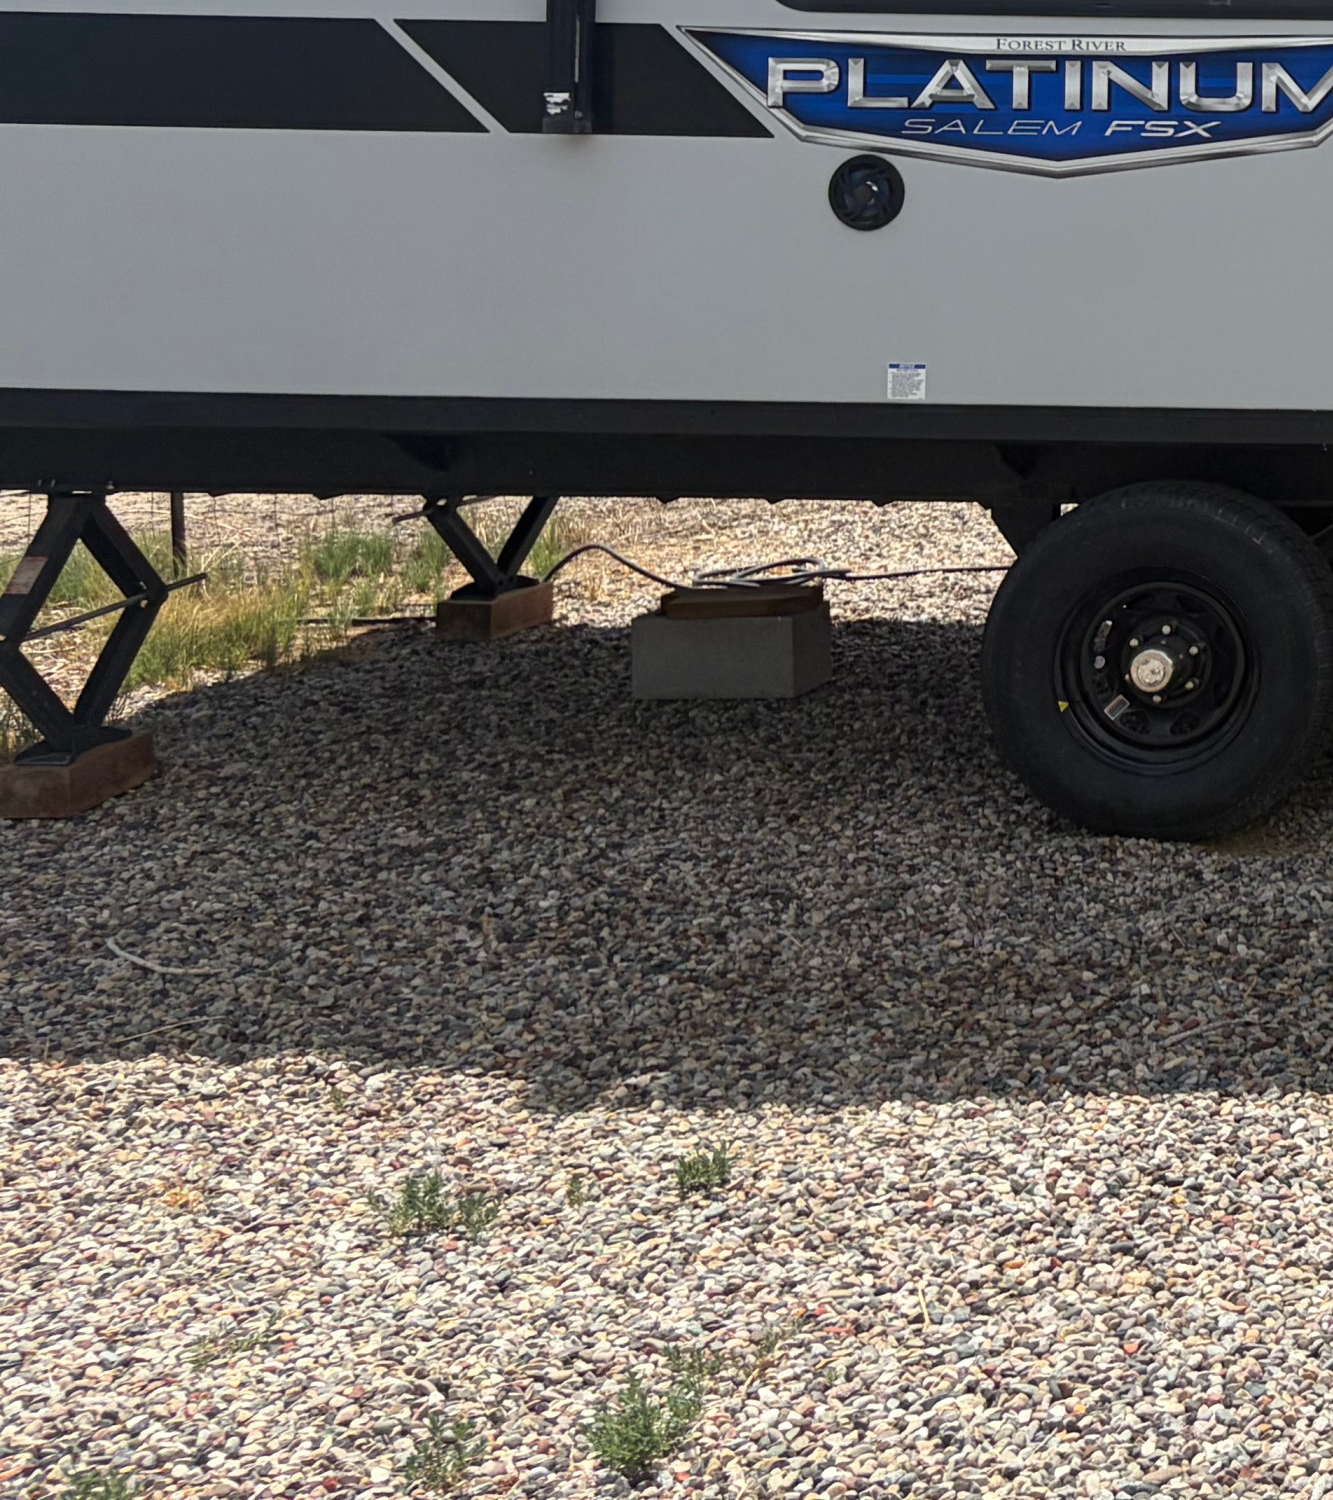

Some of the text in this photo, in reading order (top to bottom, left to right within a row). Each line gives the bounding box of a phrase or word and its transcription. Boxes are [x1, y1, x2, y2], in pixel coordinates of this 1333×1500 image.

[996, 38, 1127, 52] FOREST RIVER
[901, 118, 1221, 138] SALEM FSX
